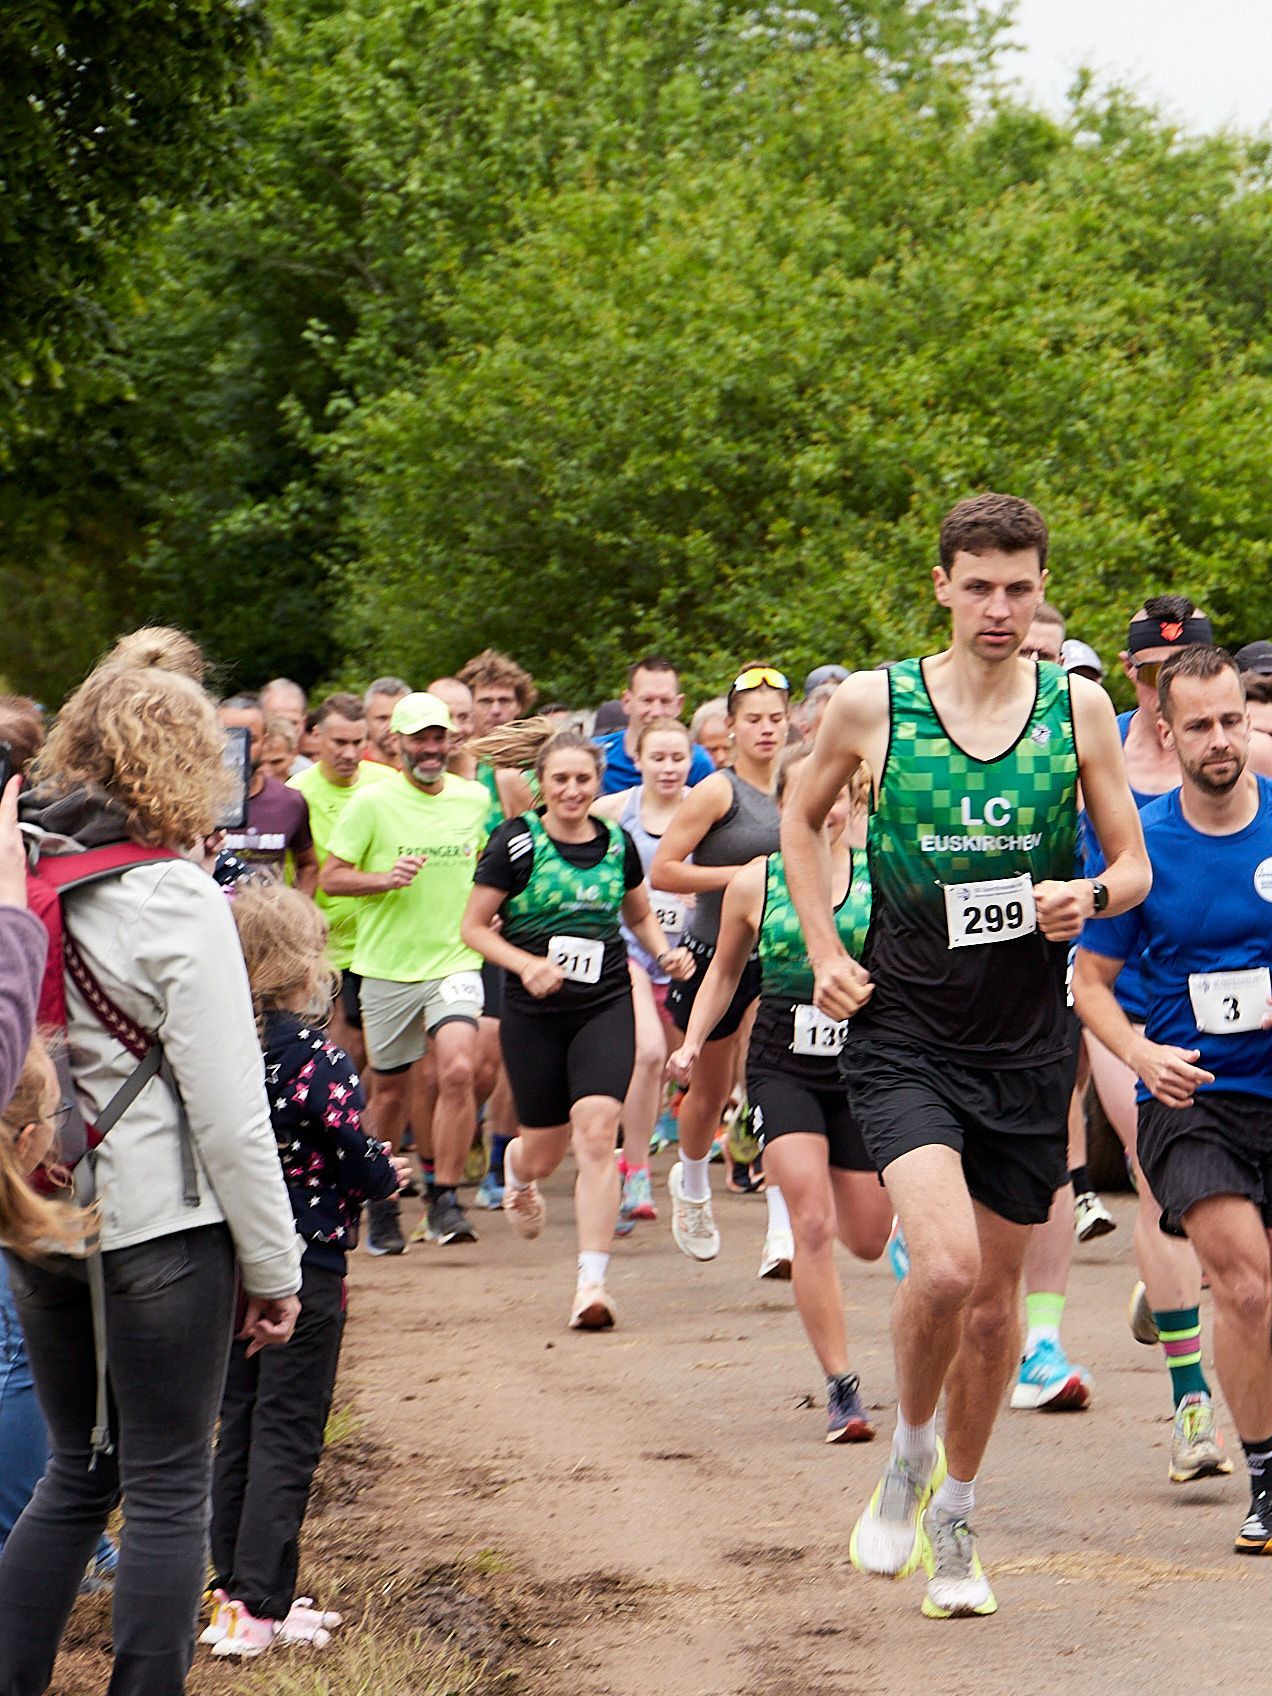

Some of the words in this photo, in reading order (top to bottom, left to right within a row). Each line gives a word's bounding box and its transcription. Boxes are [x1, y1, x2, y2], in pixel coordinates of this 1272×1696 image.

[960, 796, 1012, 827] LC
[920, 832, 1043, 852] EUSKIRCHEN
[963, 901, 1023, 935] 299
[557, 953, 592, 974] 211
[1222, 996, 1240, 1021] 3
